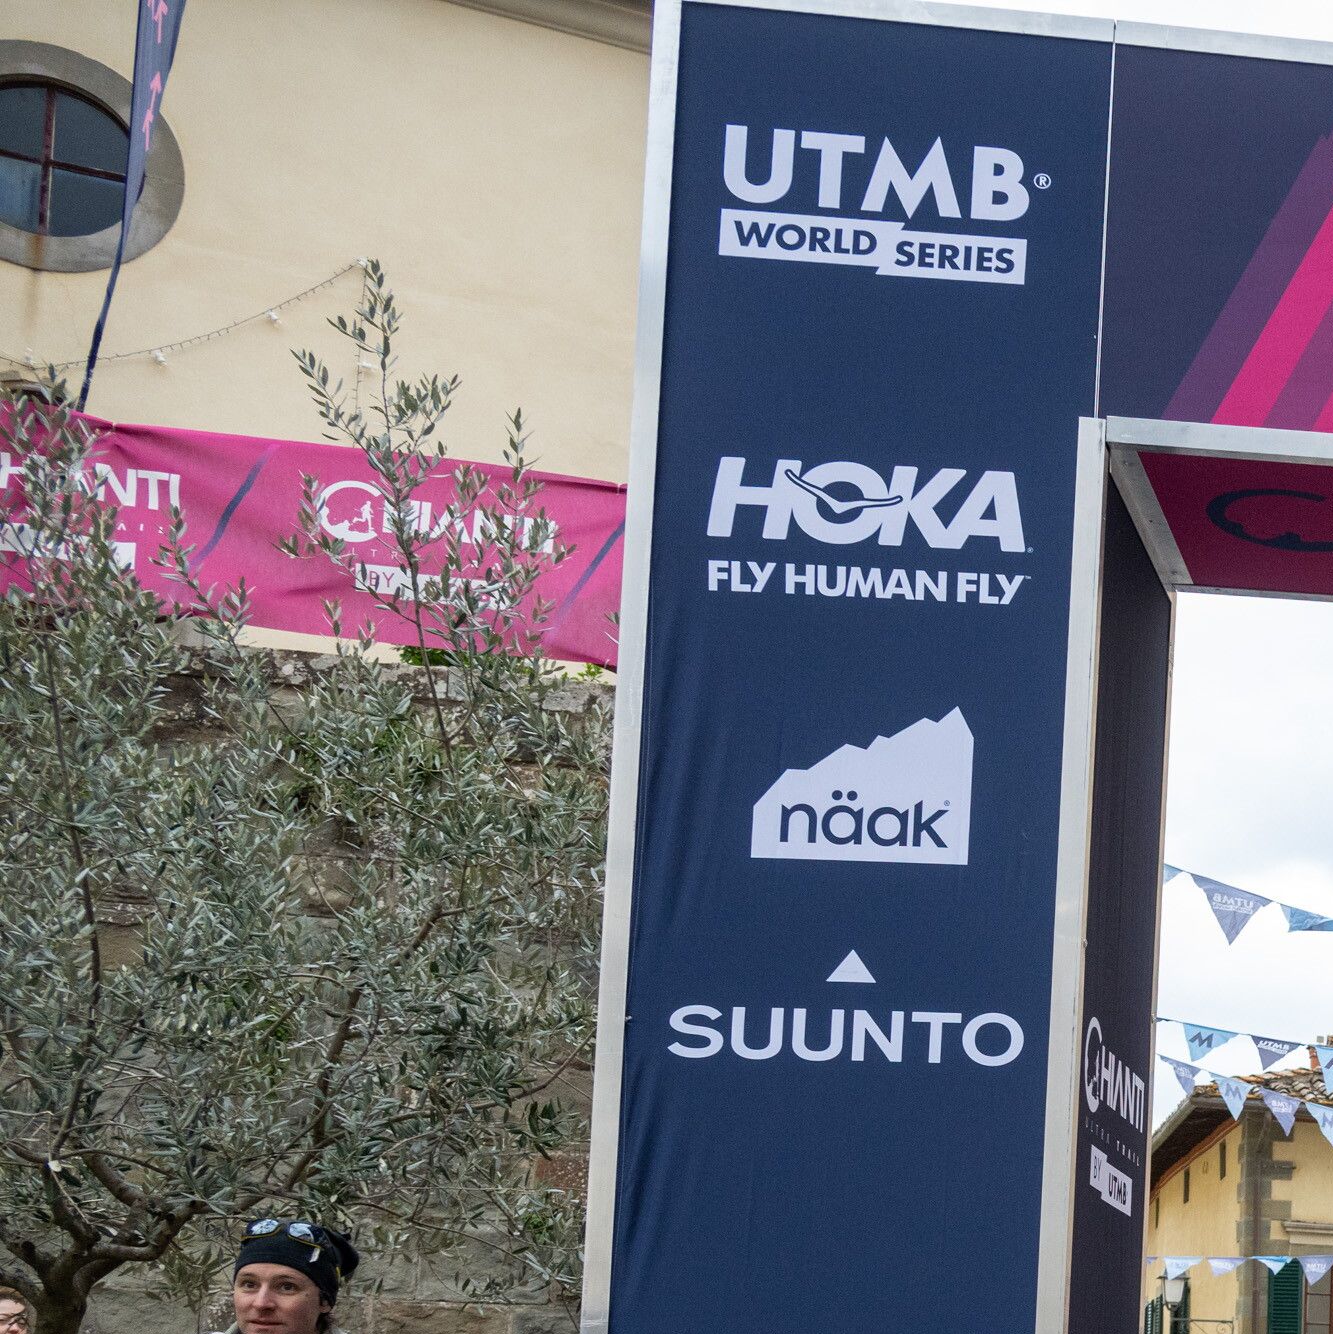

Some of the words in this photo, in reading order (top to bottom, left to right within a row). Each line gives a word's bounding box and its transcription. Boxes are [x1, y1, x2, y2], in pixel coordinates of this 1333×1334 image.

[734, 220, 878, 256] WORLD
[894, 240, 1014, 275] SERIES
[708, 560, 776, 595] FLY
[785, 563, 948, 602] HUMAN
[779, 790, 950, 849] näak
[667, 1004, 1025, 1067] SUUNTO
[1085, 1017, 1145, 1133] CHIANTI
[1108, 1171, 1128, 1205] UTMB
